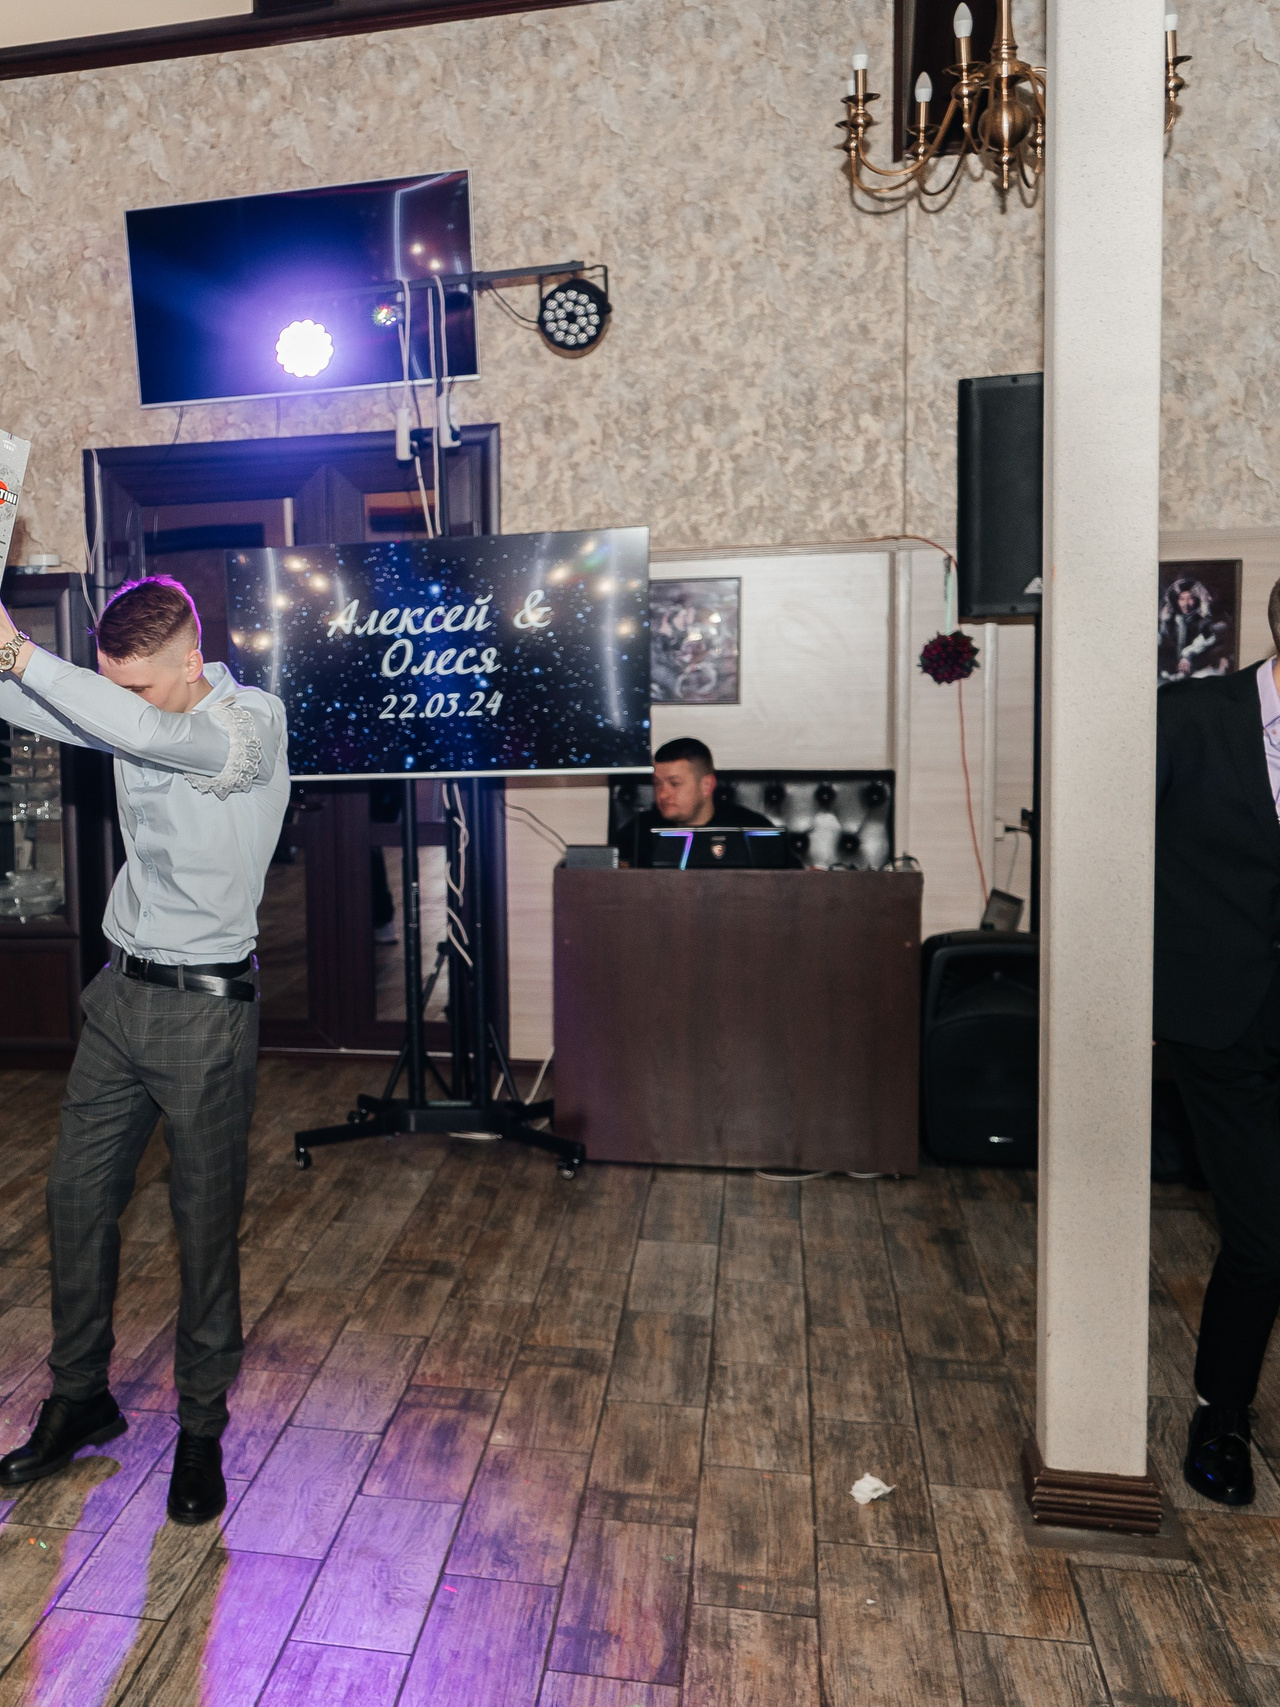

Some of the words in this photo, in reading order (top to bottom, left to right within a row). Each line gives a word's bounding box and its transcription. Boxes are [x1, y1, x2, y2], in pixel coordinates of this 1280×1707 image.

[327, 593, 493, 638] Алексей
[513, 589, 553, 629] &
[381, 638, 502, 678] Олеся
[379, 690, 504, 720] 22.03.24
